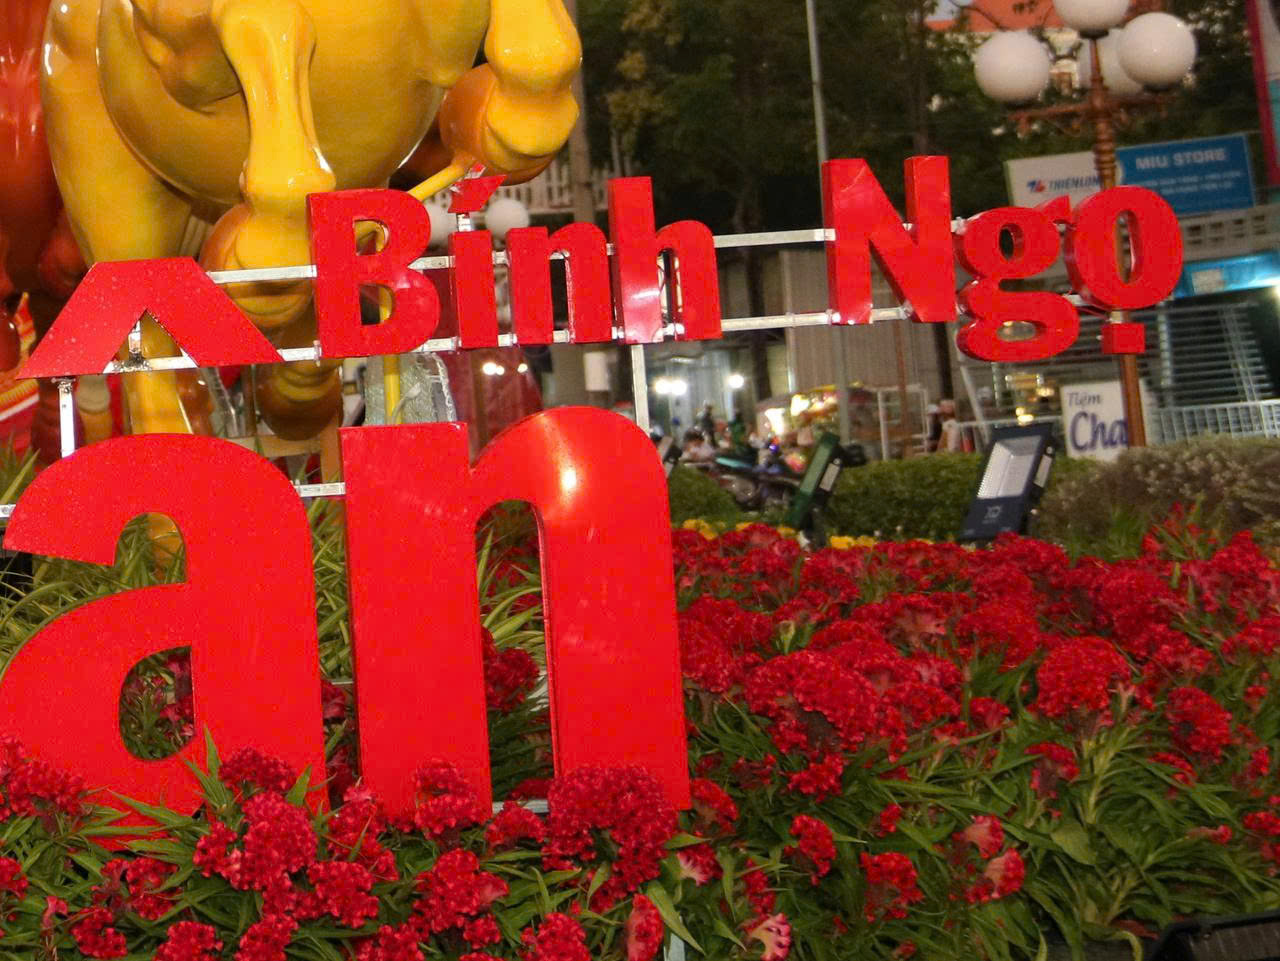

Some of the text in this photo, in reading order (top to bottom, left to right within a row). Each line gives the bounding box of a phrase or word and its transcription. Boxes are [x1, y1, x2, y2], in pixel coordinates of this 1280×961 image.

[1172, 147, 1227, 167] STORE
[307, 166, 721, 358] Bính
[824, 154, 1184, 362] Ngọ
